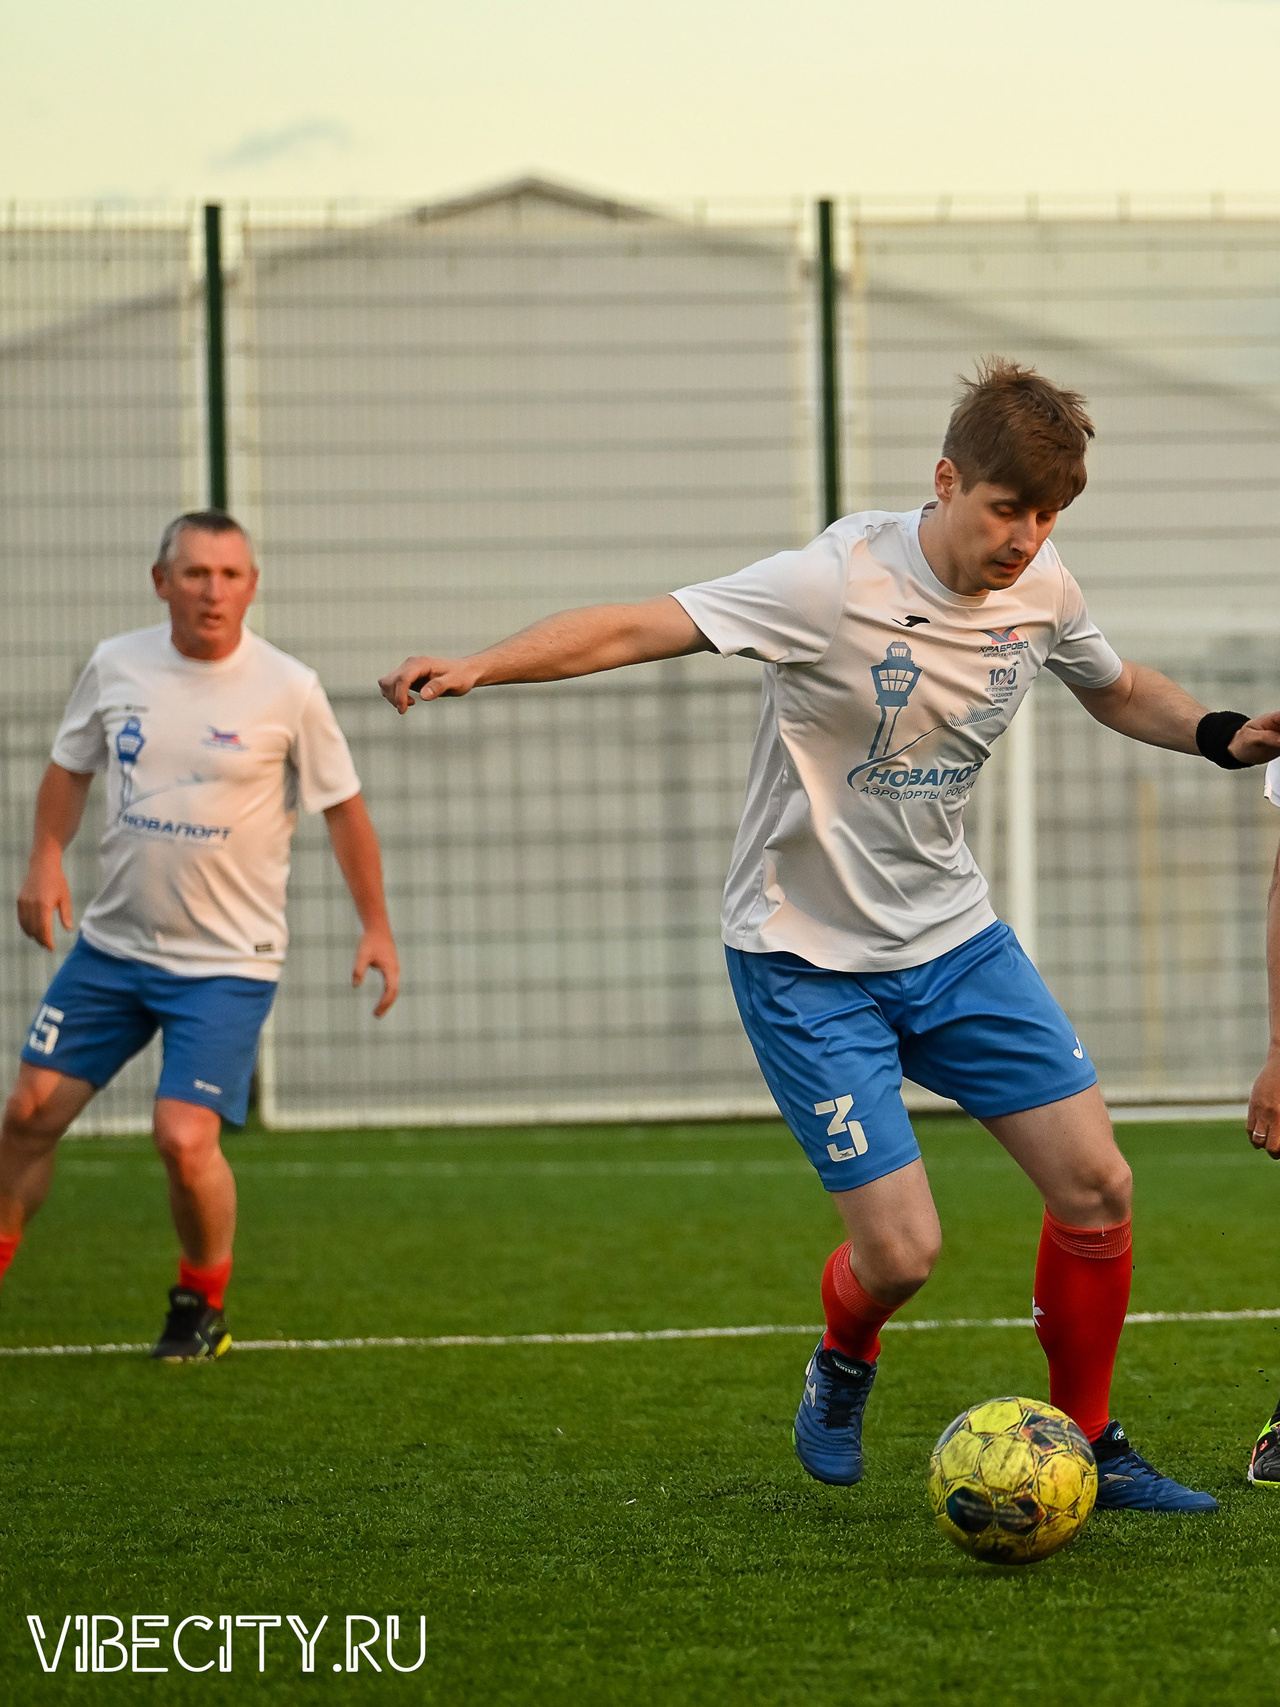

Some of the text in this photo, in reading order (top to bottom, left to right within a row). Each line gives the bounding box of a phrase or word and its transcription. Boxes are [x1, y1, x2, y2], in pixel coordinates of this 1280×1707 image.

[978, 641, 1029, 653] ХРАБРОВО
[989, 667, 1016, 686] 100
[866, 761, 983, 788] НОВАПОР
[860, 786, 940, 801] АЭРОПОРТЫ
[28, 1003, 65, 1055] 5
[814, 1094, 869, 1162] 3
